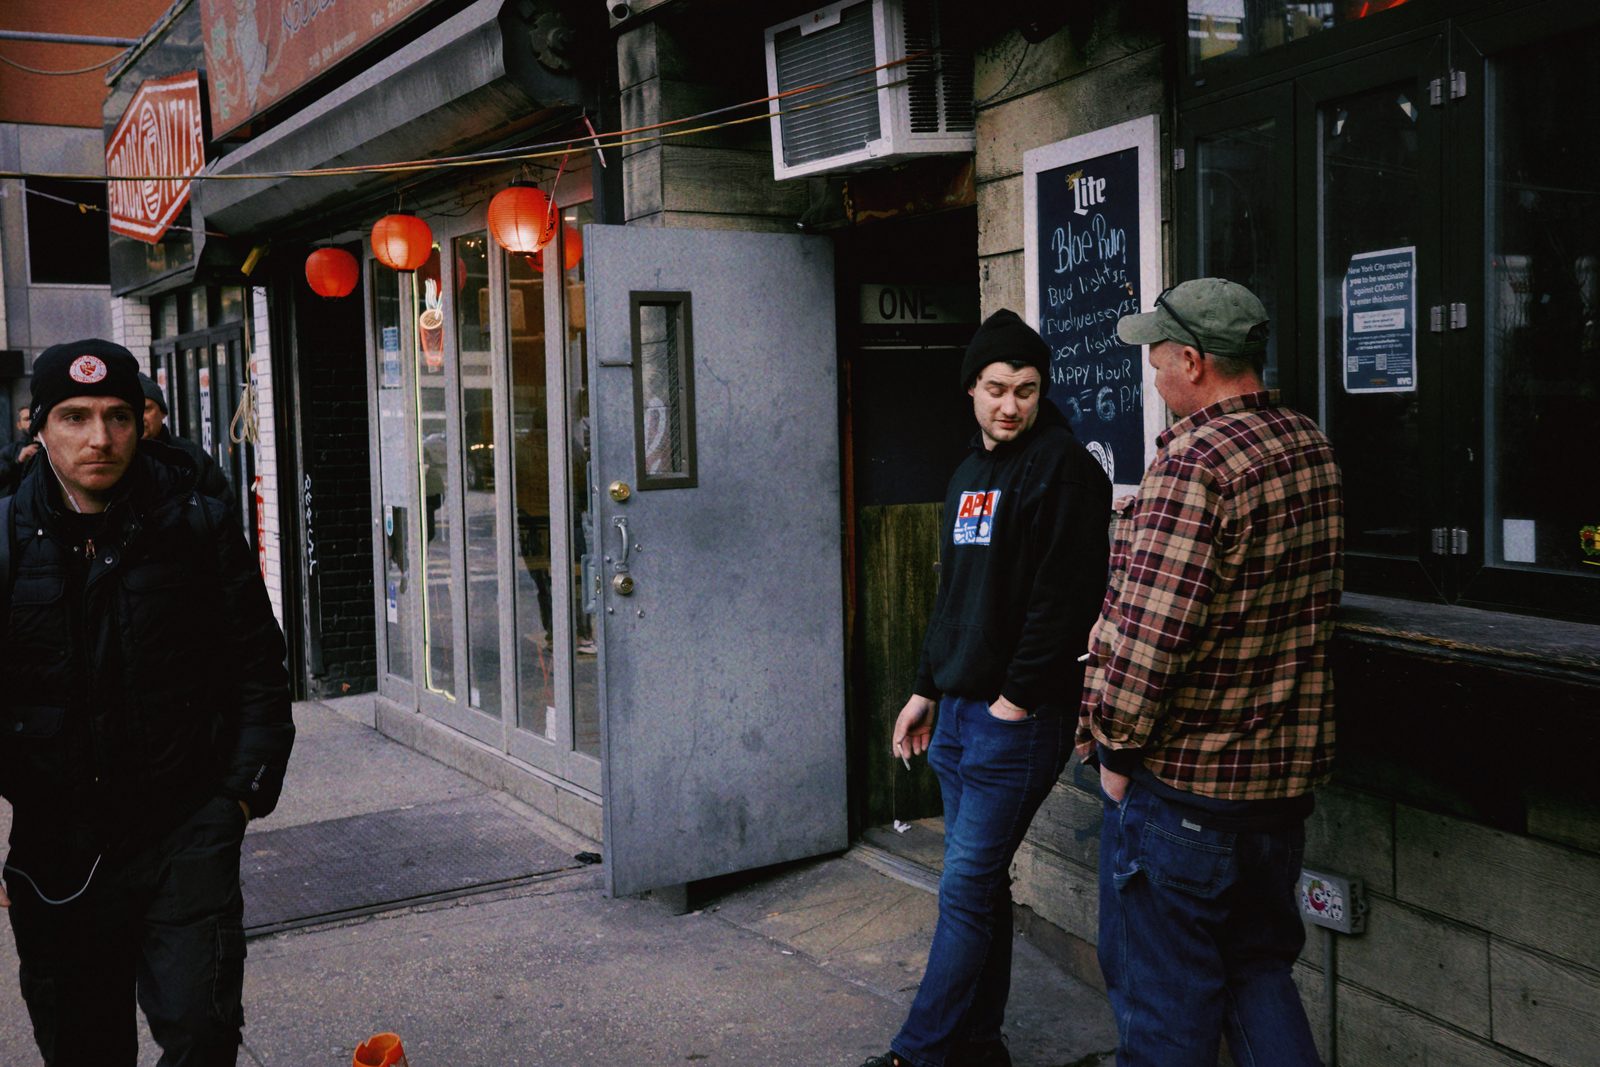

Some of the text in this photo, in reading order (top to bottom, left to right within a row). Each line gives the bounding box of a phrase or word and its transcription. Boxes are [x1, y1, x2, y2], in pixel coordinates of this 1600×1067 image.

[1072, 176, 1106, 216] Lite
[1361, 264, 1374, 273] York
[1374, 263, 1386, 273] City
[1048, 283, 1073, 307] Bud
[1374, 282, 1405, 293] COVID-19
[879, 287, 938, 320] ONE
[960, 492, 995, 518] APA
